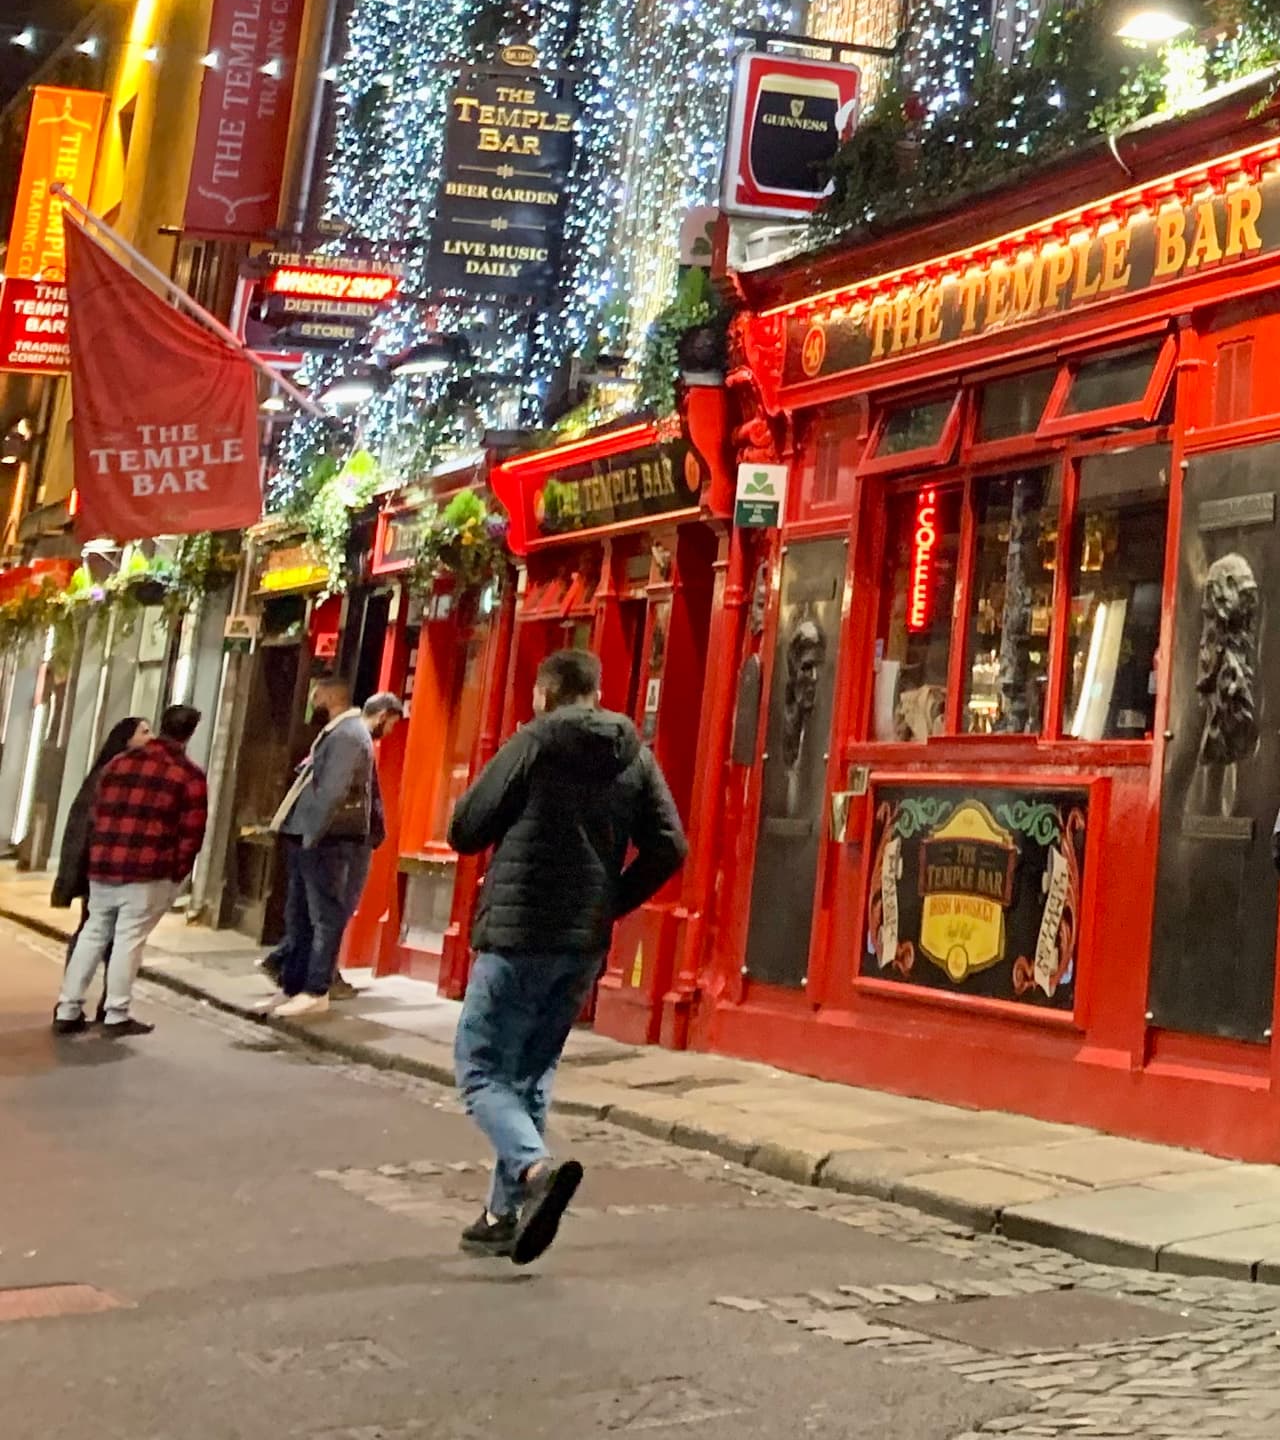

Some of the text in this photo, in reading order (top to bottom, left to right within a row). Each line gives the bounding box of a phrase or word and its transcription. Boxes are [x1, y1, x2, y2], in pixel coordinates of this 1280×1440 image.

[257, 14, 288, 119] TRAING
[495, 87, 535, 104] THE
[454, 97, 572, 133] TEMPLE
[762, 113, 829, 133] GUINNESS
[212, 118, 246, 184] THE
[477, 127, 541, 156] BAR
[55, 132, 82, 180] THE
[446, 181, 559, 205] BEER GARDEN
[21, 178, 47, 250] TRADING
[268, 251, 405, 275] THE TEMPLE BAR
[443, 239, 549, 262] LIVE MUSIC
[466, 260, 523, 278] DAILY
[869, 188, 1264, 359] THE TEMPLE BAR
[34, 285, 68, 300] THE
[274, 269, 393, 300] WHISKEY SHOP
[284, 298, 379, 317] DISTILLERY
[25, 318, 68, 333] BAR
[300, 322, 356, 339] STORE
[15, 340, 70, 354] TRADING
[804, 335, 822, 367] 48
[137, 424, 199, 445] THE
[89, 438, 244, 474] TEMPLE
[132, 469, 209, 497] BAR
[583, 467, 641, 511] TEMPLE
[640, 456, 677, 501] BAR
[911, 508, 936, 627] COFFEE
[956, 844, 977, 864] THE
[926, 865, 1004, 896] TEMPLE BAR
[930, 895, 994, 923] IRISH WHISKEY
